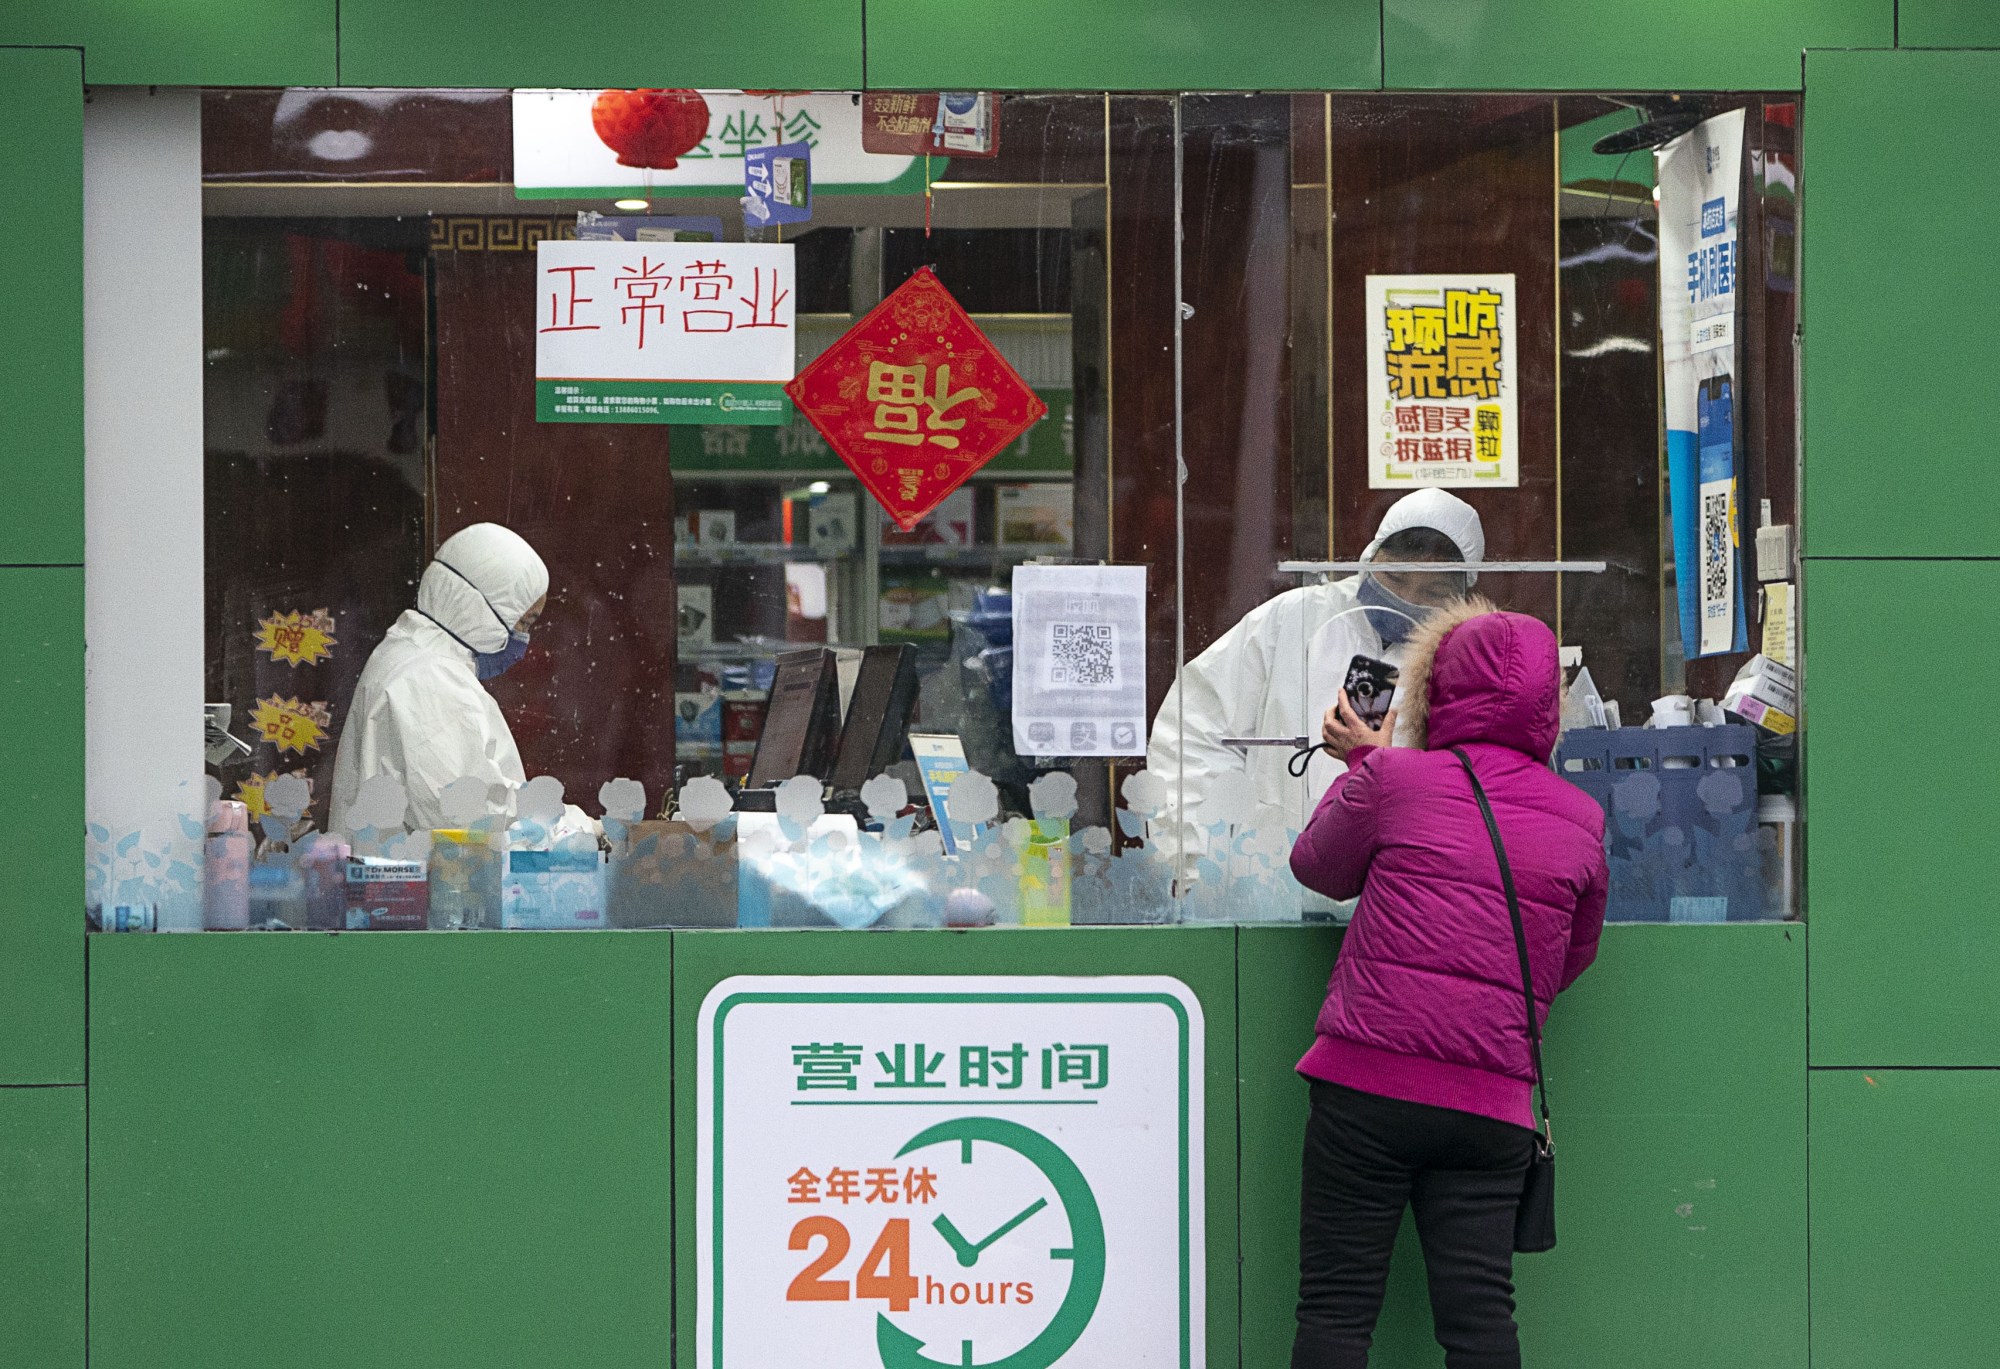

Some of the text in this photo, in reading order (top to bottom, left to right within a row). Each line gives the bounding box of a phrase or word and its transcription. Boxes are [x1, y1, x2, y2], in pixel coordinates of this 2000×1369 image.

[876, 115, 931, 132] 不含防腐剂
[539, 256, 789, 349] 正常营业
[864, 360, 983, 449] 福
[1395, 405, 1470, 432] 感冒灵
[1395, 437, 1472, 462] 板蓝根
[1477, 409, 1500, 457] 颗粒
[791, 1042, 1110, 1091] 营业时间
[787, 1166, 938, 1205] 全年无休
[786, 1215, 1034, 1312] 24 hours
